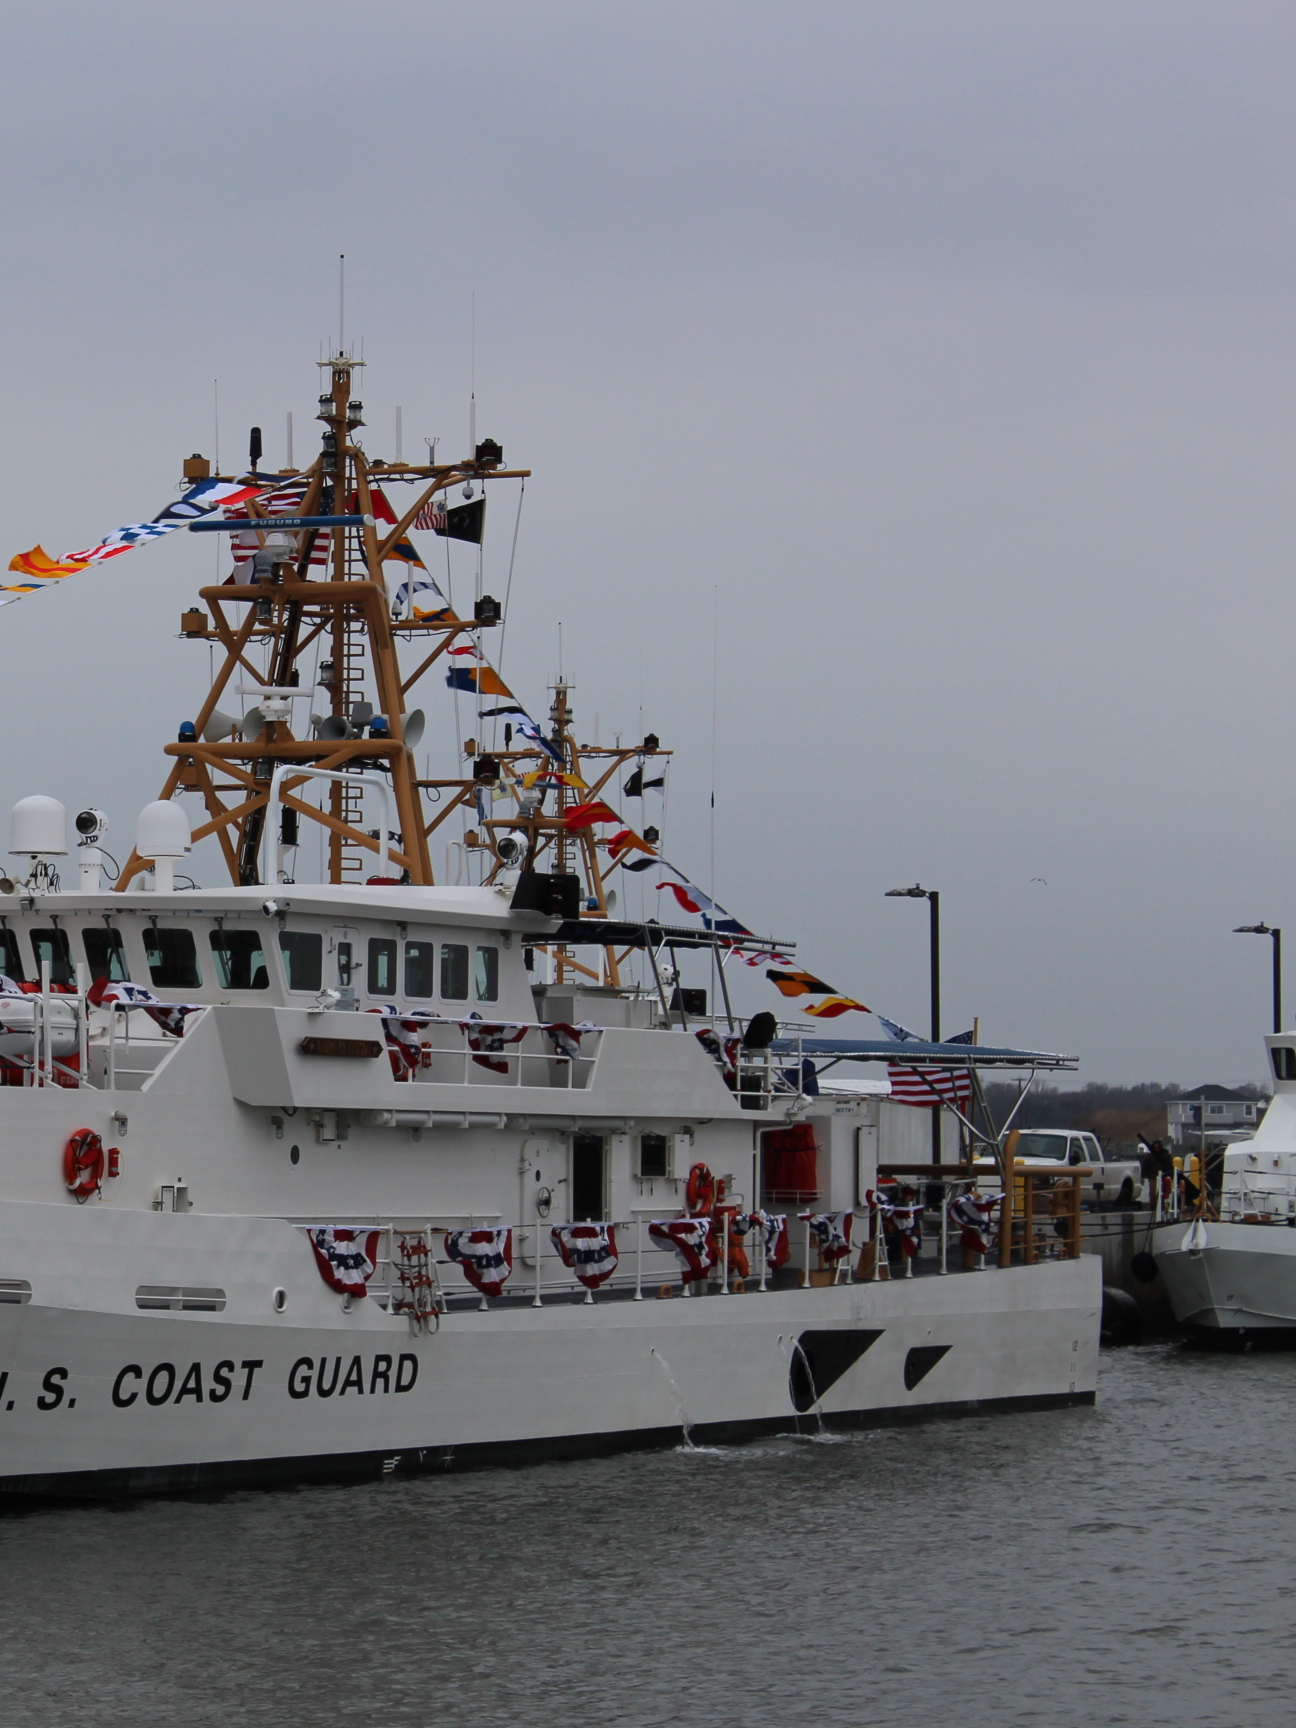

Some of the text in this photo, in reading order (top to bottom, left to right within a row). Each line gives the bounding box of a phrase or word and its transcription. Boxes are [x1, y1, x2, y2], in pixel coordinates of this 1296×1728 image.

[250, 518, 301, 526] FURUNO
[36, 1366, 77, 1411] S.
[111, 1359, 264, 1409] COAST
[287, 1352, 419, 1400] GUARD
